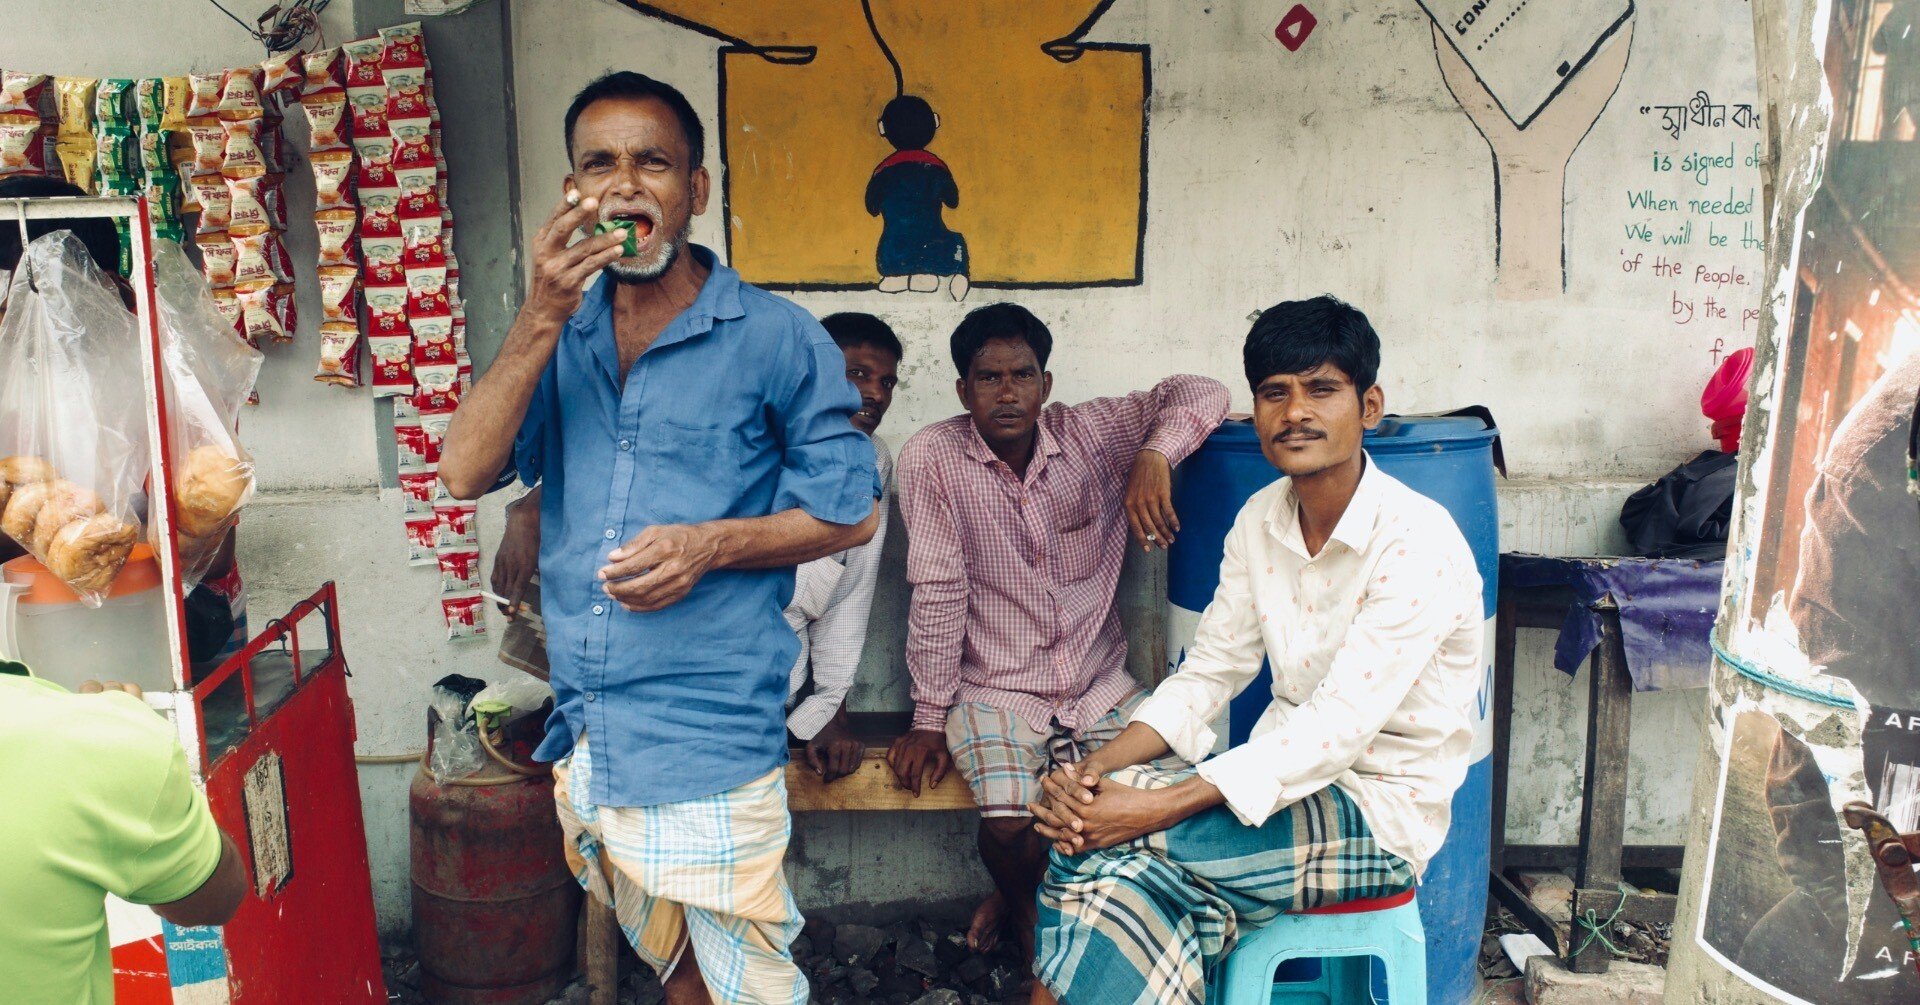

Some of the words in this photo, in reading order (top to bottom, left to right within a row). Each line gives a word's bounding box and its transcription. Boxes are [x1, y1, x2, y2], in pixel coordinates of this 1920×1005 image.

[1455, 0, 1490, 35] CON
[1653, 150, 1672, 172] is
[1681, 141, 1734, 186] signed
[1627, 190, 1678, 211] When
[1688, 186, 1753, 215] needed
[1624, 223, 1653, 242] We
[1662, 220, 1692, 246] will
[1708, 221, 1728, 247] be
[1739, 220, 1765, 252] the
[1651, 255, 1682, 278] the
[1672, 290, 1694, 325] by
[1703, 295, 1728, 319] the
